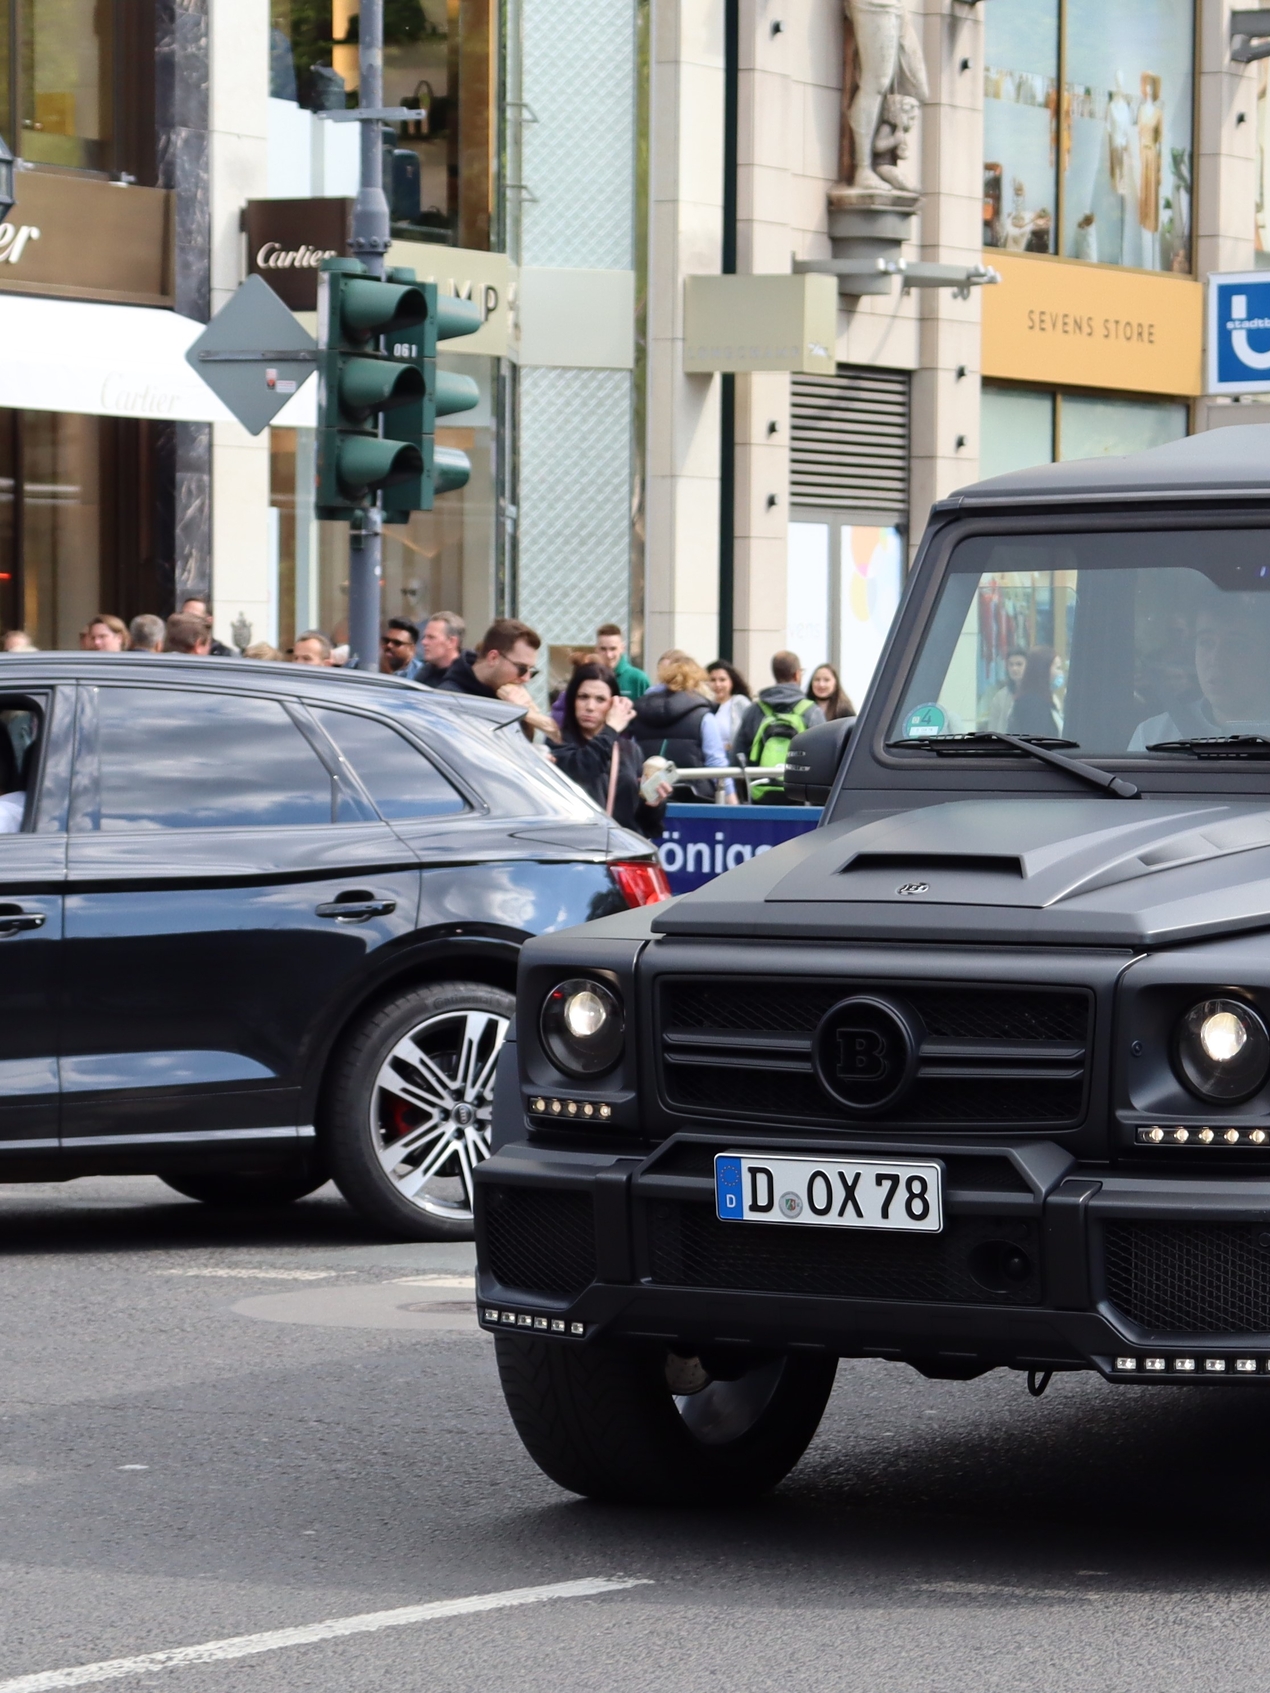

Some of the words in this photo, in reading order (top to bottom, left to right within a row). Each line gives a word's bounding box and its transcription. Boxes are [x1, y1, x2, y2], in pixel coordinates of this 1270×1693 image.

[1027, 309, 1094, 337] SEVENS
[1103, 318, 1155, 344] STORE
[394, 343, 418, 358] 061
[726, 1194, 736, 1208] D
[748, 1166, 774, 1213] D
[807, 1170, 864, 1217] OX
[875, 1173, 930, 1221] 78
